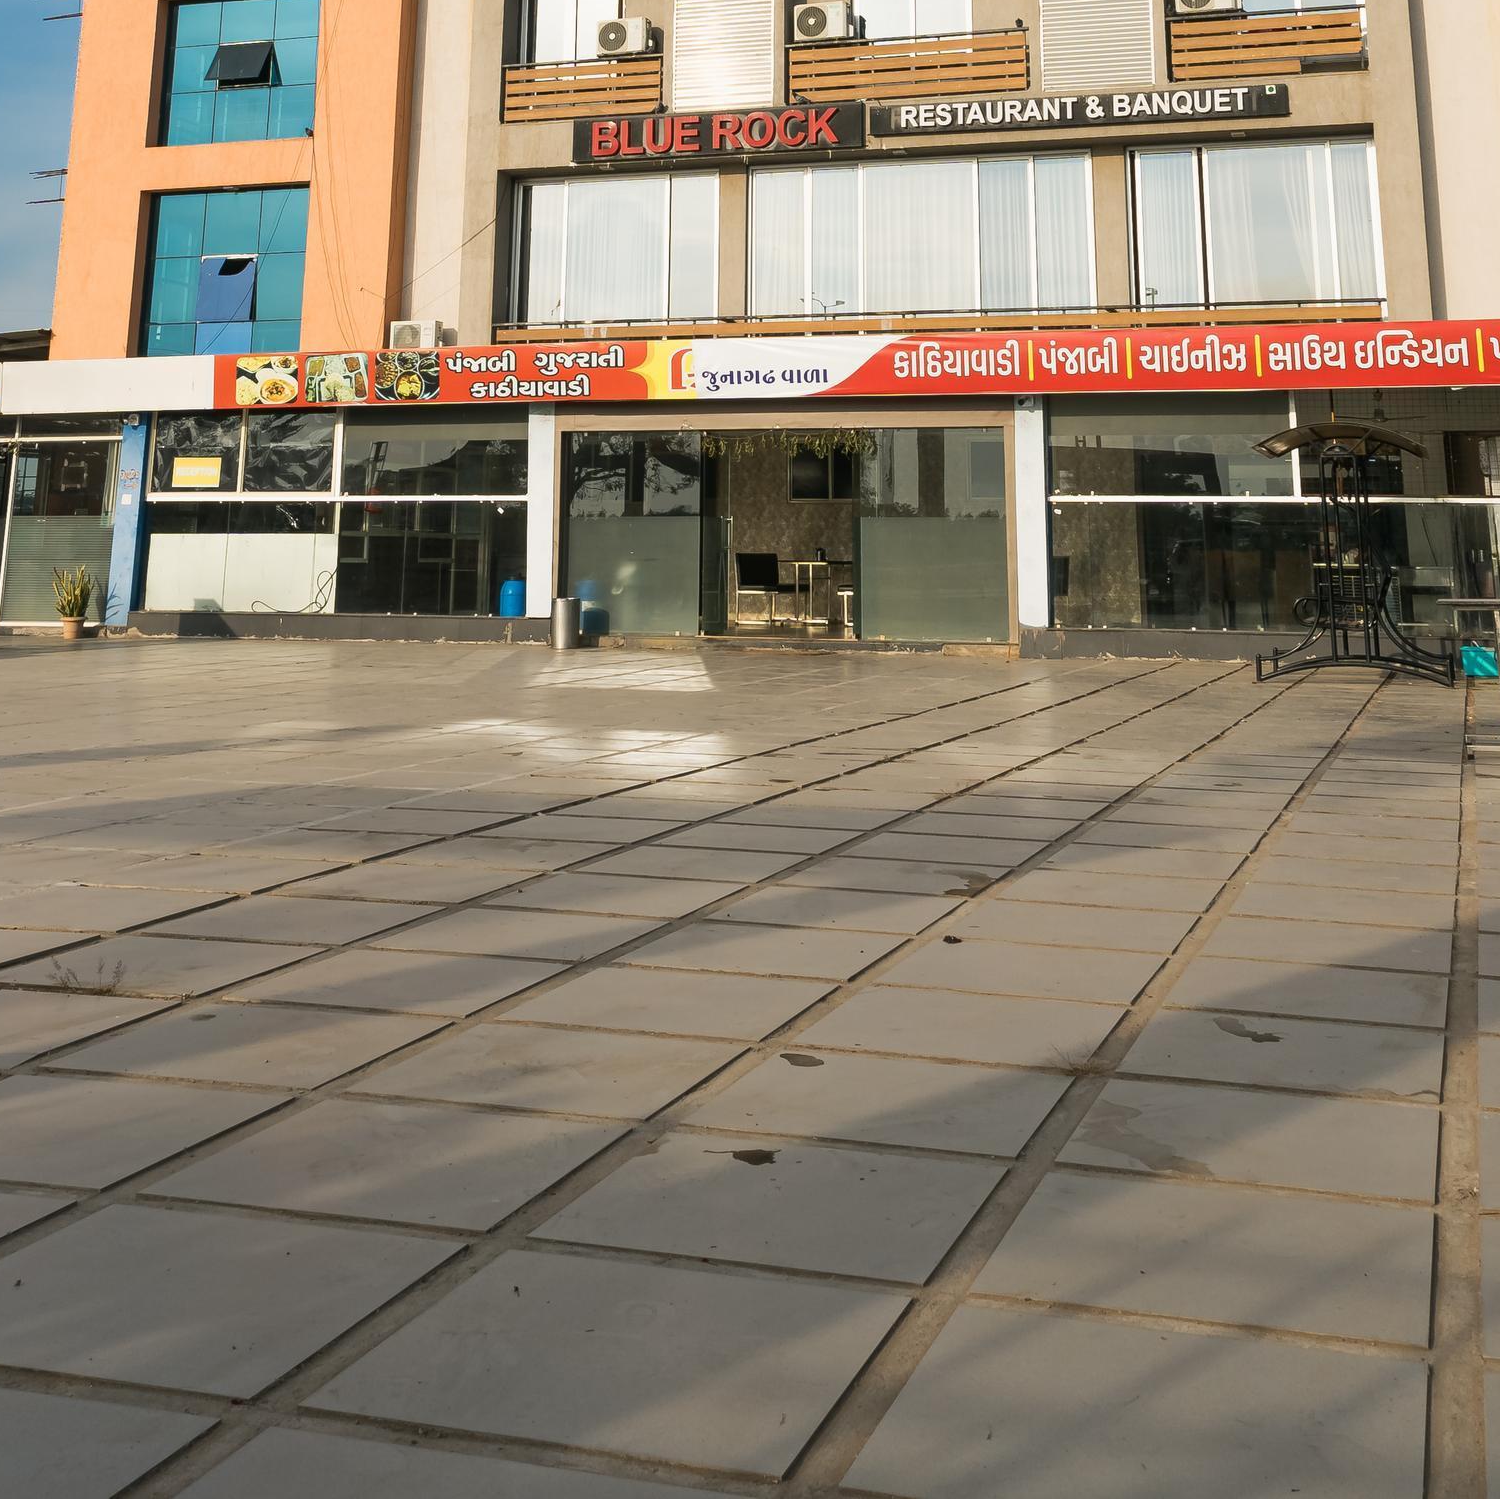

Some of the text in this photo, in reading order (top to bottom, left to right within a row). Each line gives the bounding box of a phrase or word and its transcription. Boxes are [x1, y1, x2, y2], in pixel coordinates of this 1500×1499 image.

[900, 87, 1249, 128] RESTAURANT & BANQUET
[591, 107, 840, 157] BLUE ROCK
[445, 344, 625, 376] પંજાબી ગુજરાતી
[893, 338, 1021, 378] કાઠિયાવાડી
[1038, 336, 1119, 375] પંજાબી
[1138, 334, 1248, 373] ચાઈનીઝ
[1268, 334, 1347, 372] સાઉથ
[1354, 329, 1470, 369] ઇન્ડિયન
[469, 373, 591, 399] કાઠીયાવાડી
[701, 369, 776, 392] જુનાગઢ
[781, 368, 829, 384] વાળા
